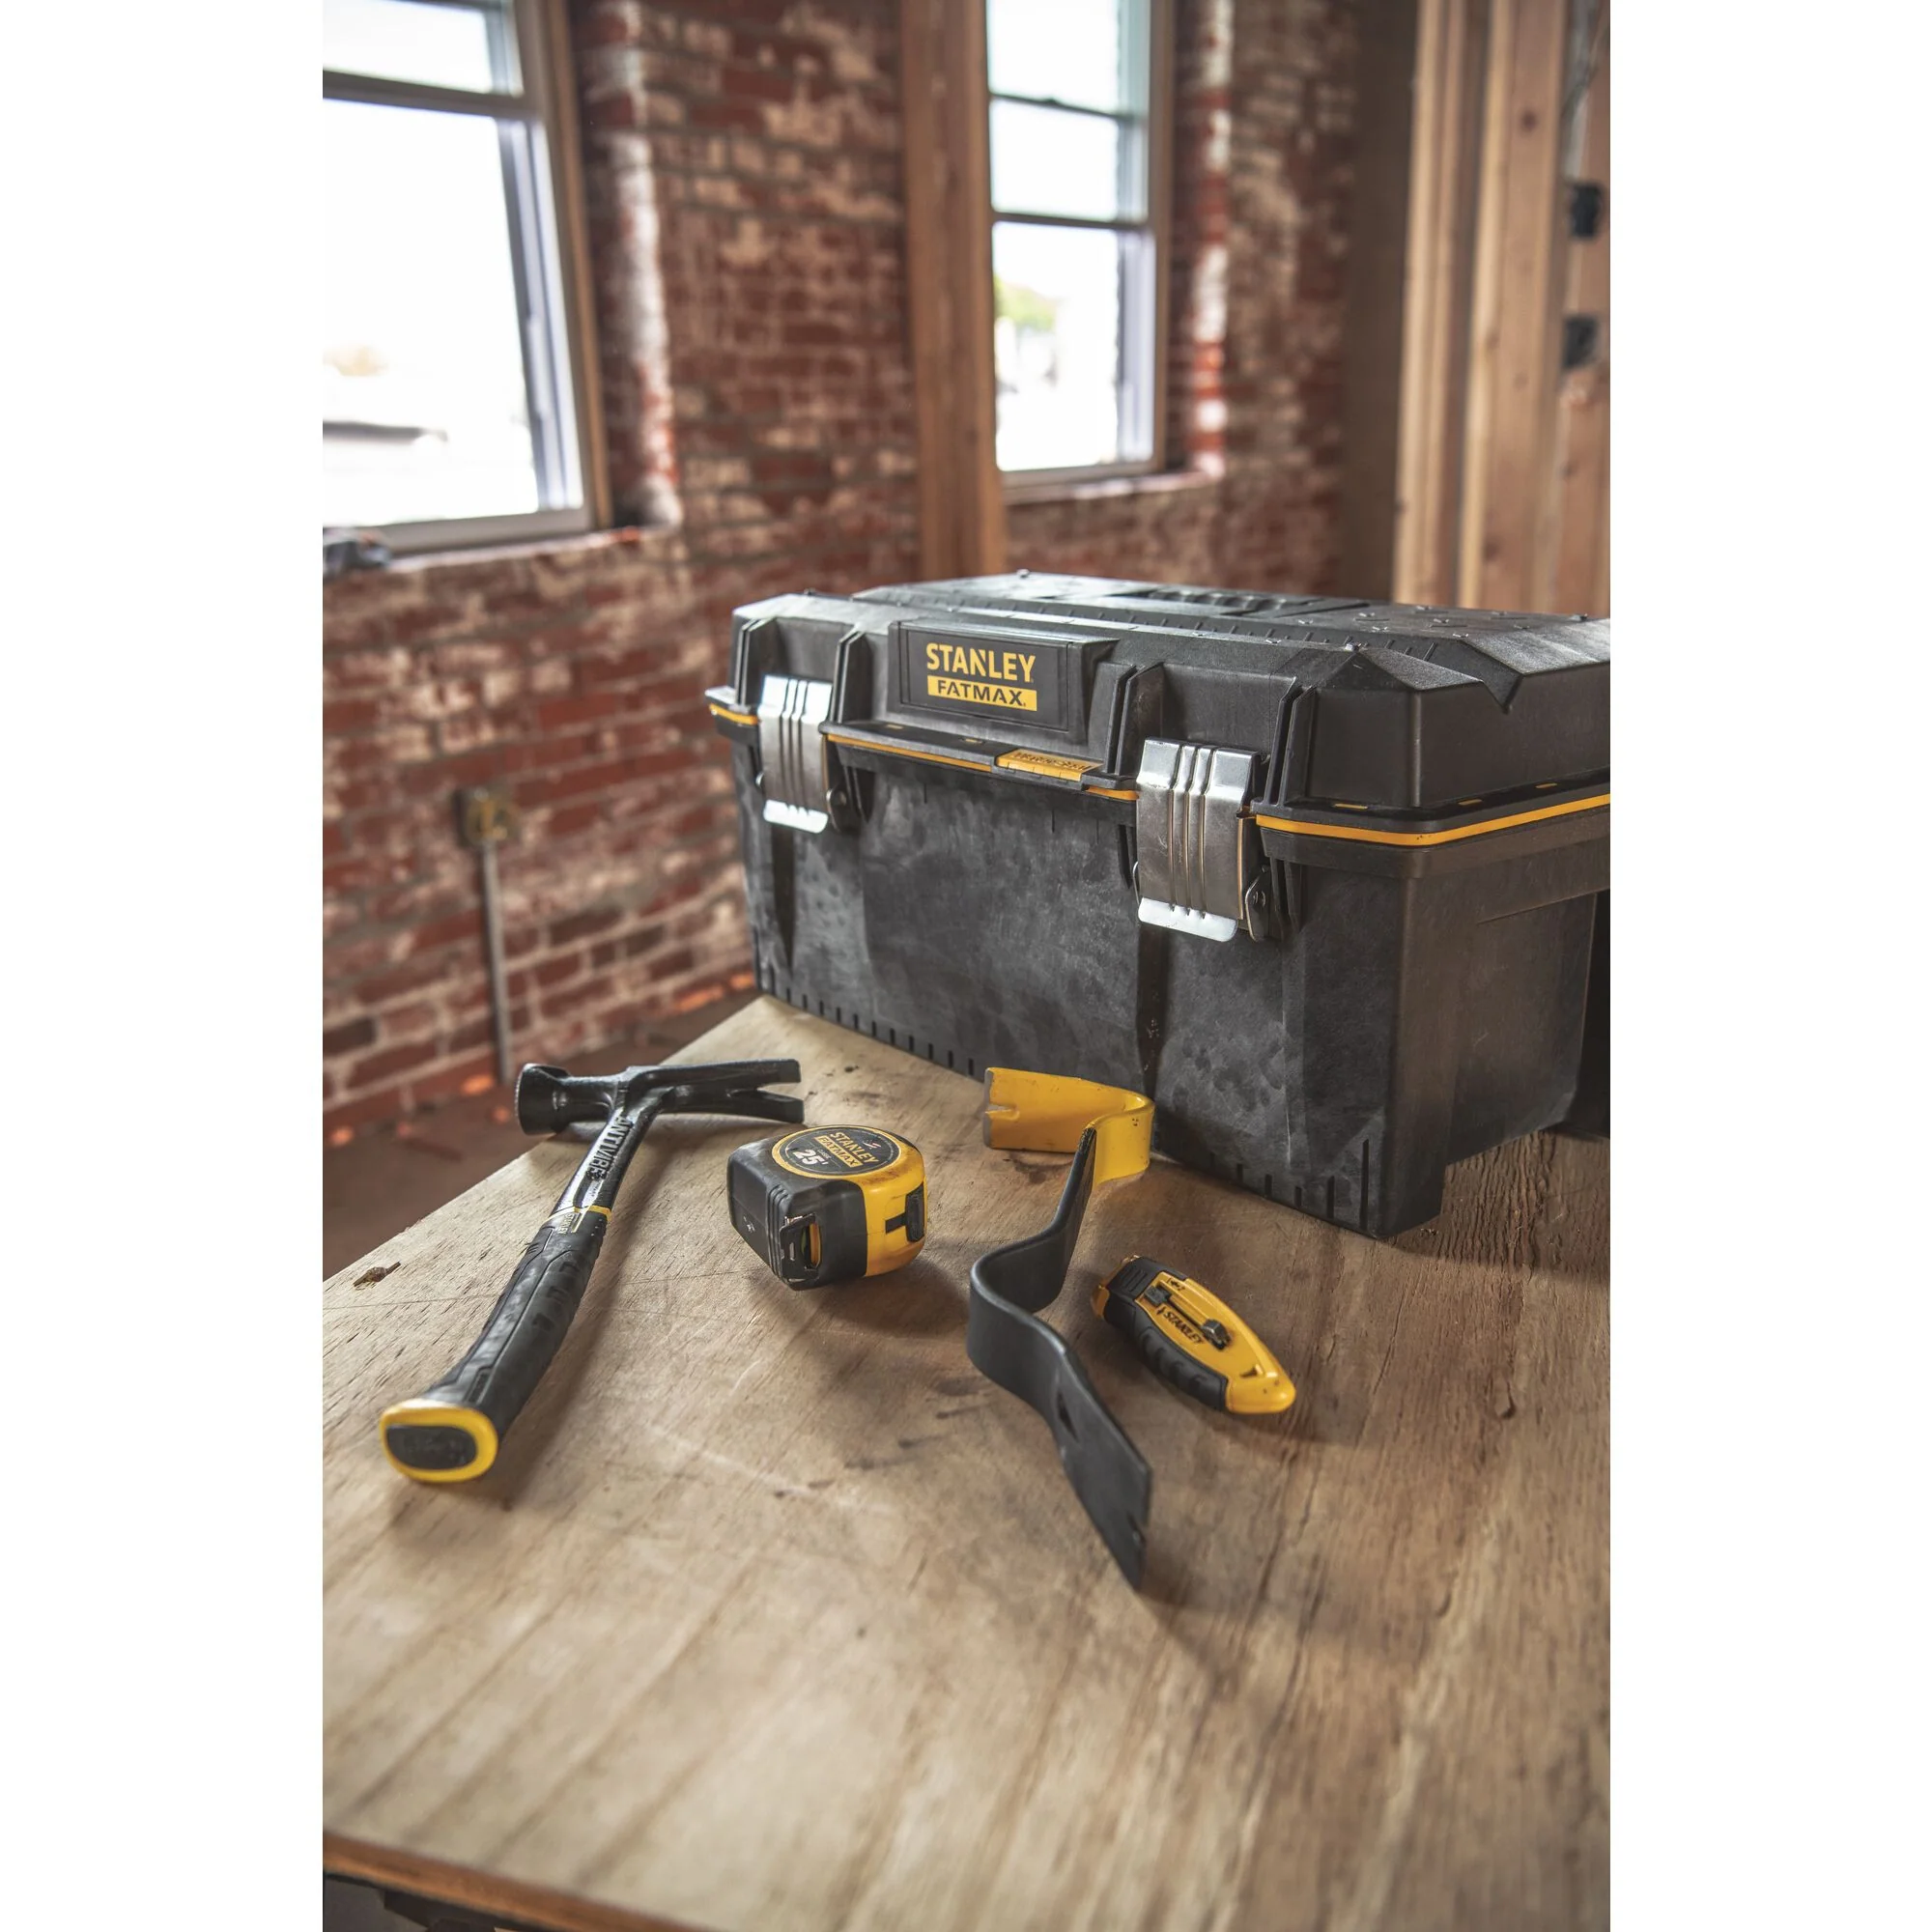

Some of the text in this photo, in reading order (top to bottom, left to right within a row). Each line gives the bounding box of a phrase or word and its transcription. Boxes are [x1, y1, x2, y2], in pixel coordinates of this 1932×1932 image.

[926, 642, 1036, 683] STANLEY
[937, 679, 1025, 706] FATMAX
[819, 1137, 859, 1165] FATMAX
[831, 1131, 879, 1163] STANLEY
[1164, 1311, 1205, 1344] STANLEY
